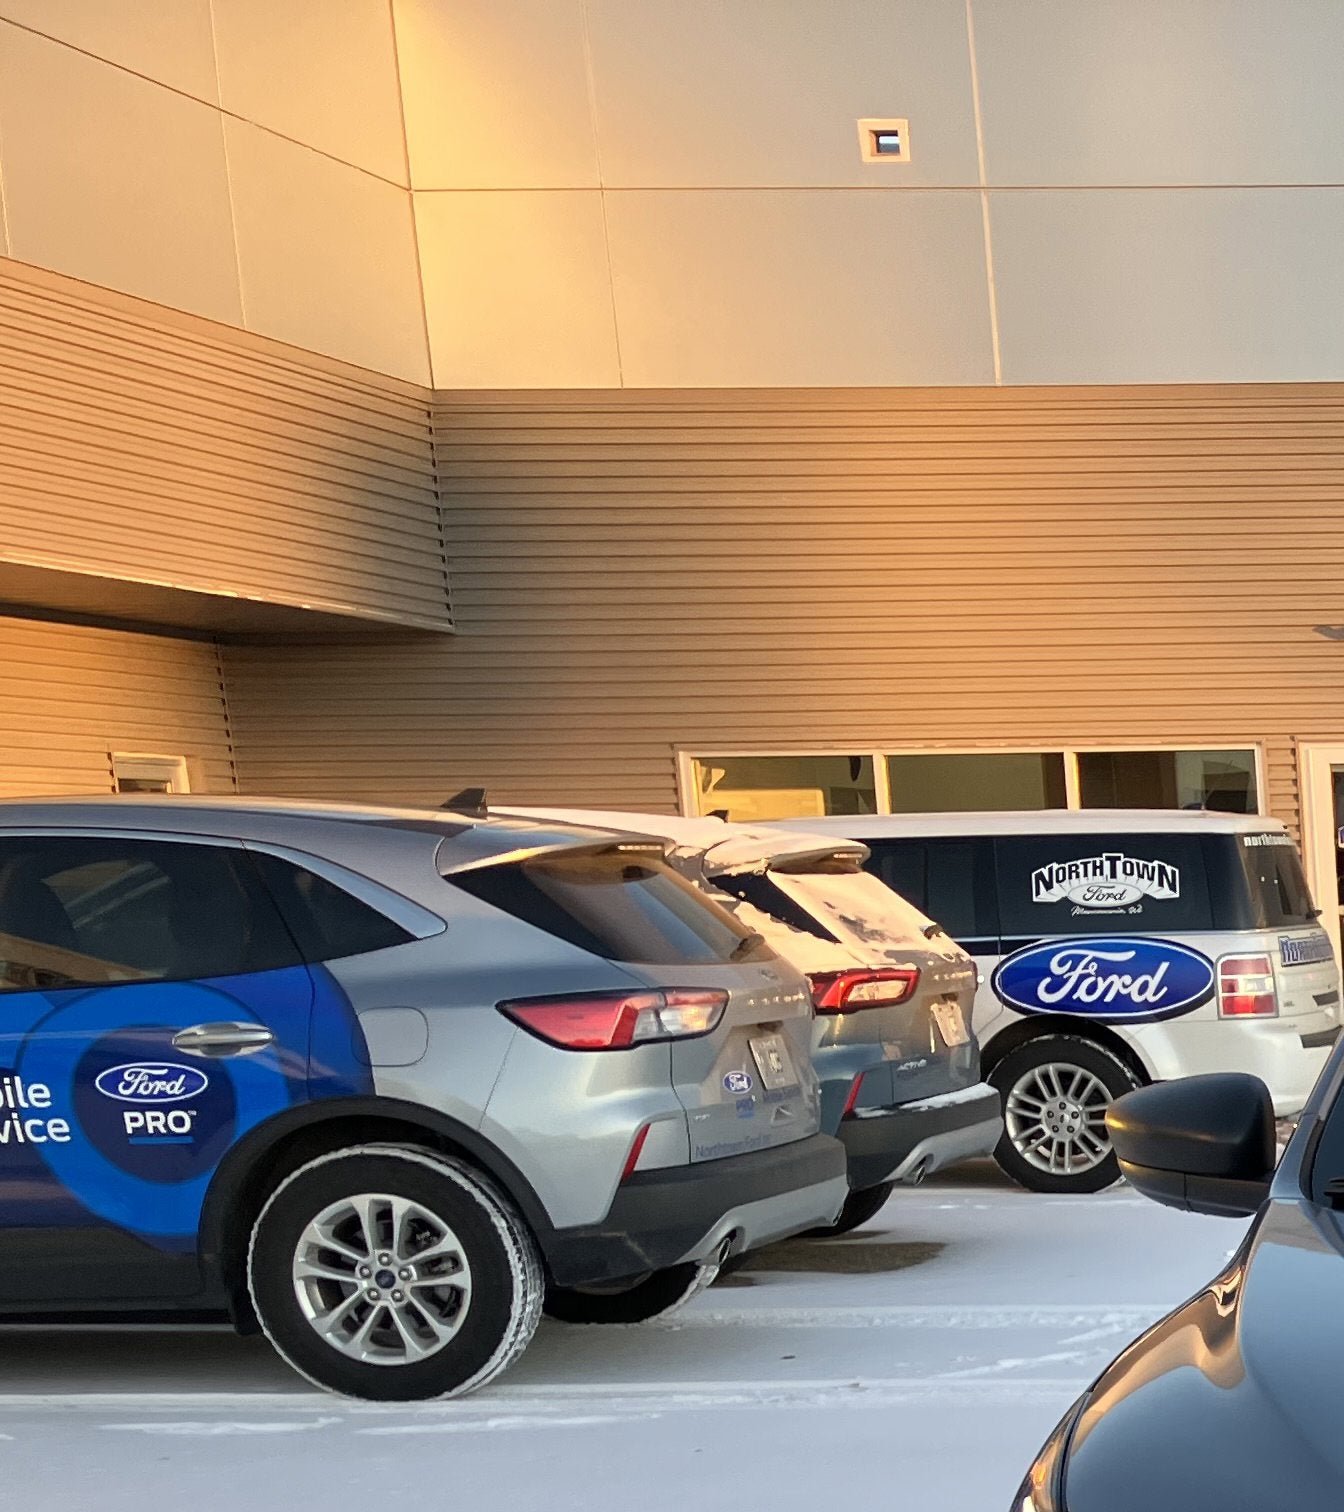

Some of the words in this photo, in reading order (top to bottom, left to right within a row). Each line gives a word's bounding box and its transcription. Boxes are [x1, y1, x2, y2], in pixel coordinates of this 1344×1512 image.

[1033, 854, 1178, 898] NORTHTOWN
[1082, 885, 1128, 902] Ford
[1036, 948, 1171, 1004] Ford
[0, 1075, 52, 1109] ile
[118, 1067, 187, 1096] Ford
[124, 1110, 192, 1134] PRO
